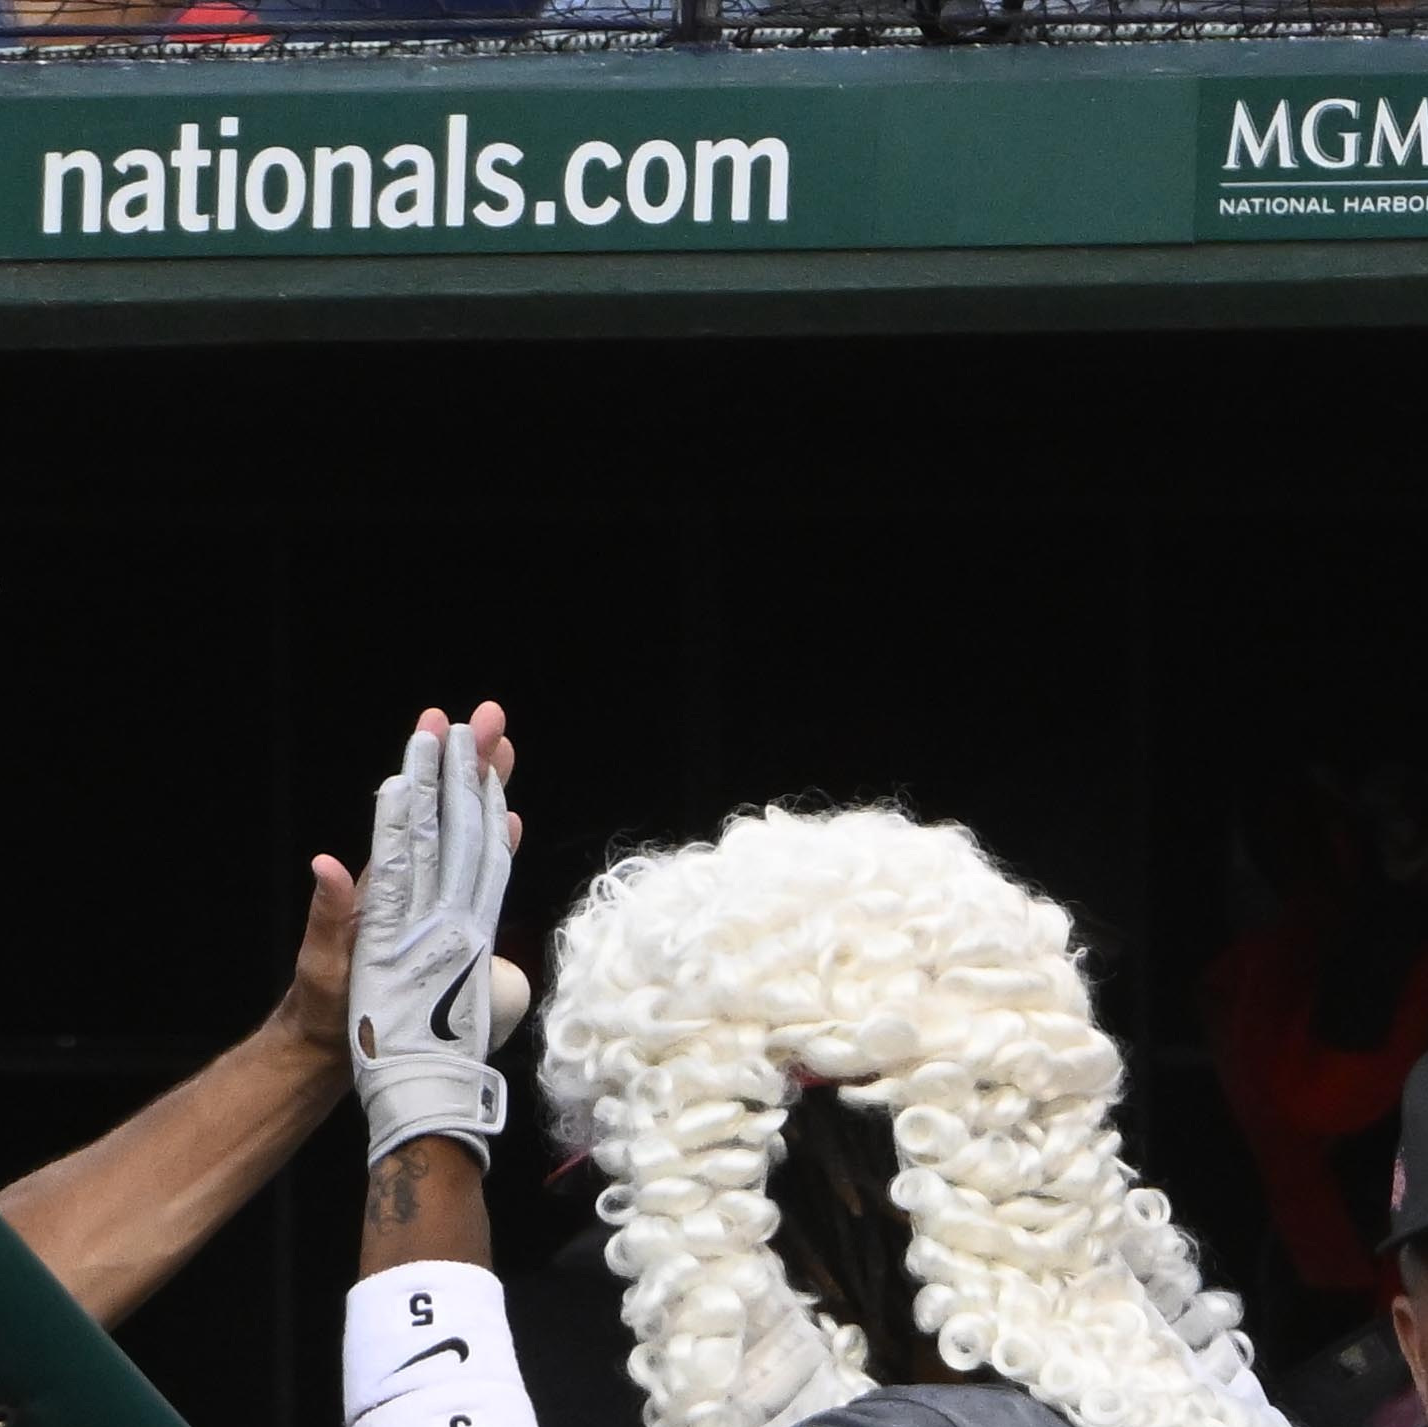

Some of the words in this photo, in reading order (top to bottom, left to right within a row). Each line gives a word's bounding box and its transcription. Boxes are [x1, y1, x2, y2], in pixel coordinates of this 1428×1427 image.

[42, 113, 790, 234] nationals.com
[1219, 196, 1336, 215] NATIONAL
[409, 1293, 434, 1327] 5
